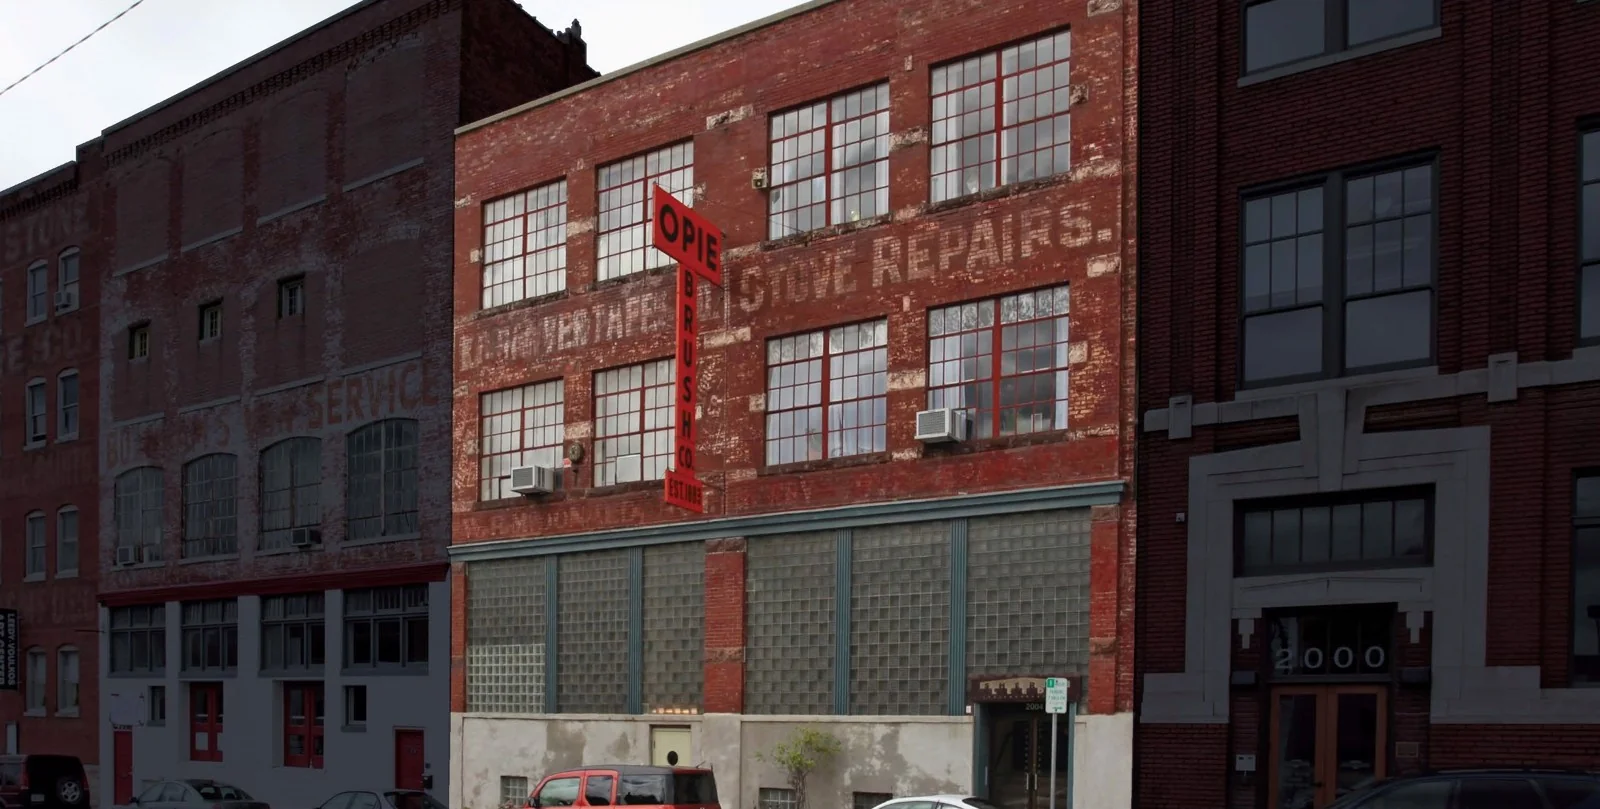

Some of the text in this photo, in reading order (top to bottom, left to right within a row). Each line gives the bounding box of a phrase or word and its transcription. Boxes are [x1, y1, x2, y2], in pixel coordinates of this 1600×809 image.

[659, 203, 717, 272] OPIE
[739, 242, 857, 313] STOVE
[872, 202, 1112, 288] REPAIRS.
[682, 270, 694, 438] BRUSH
[308, 358, 439, 429] SERVICE
[678, 445, 694, 469] CO.
[1275, 645, 1386, 669] 2000
